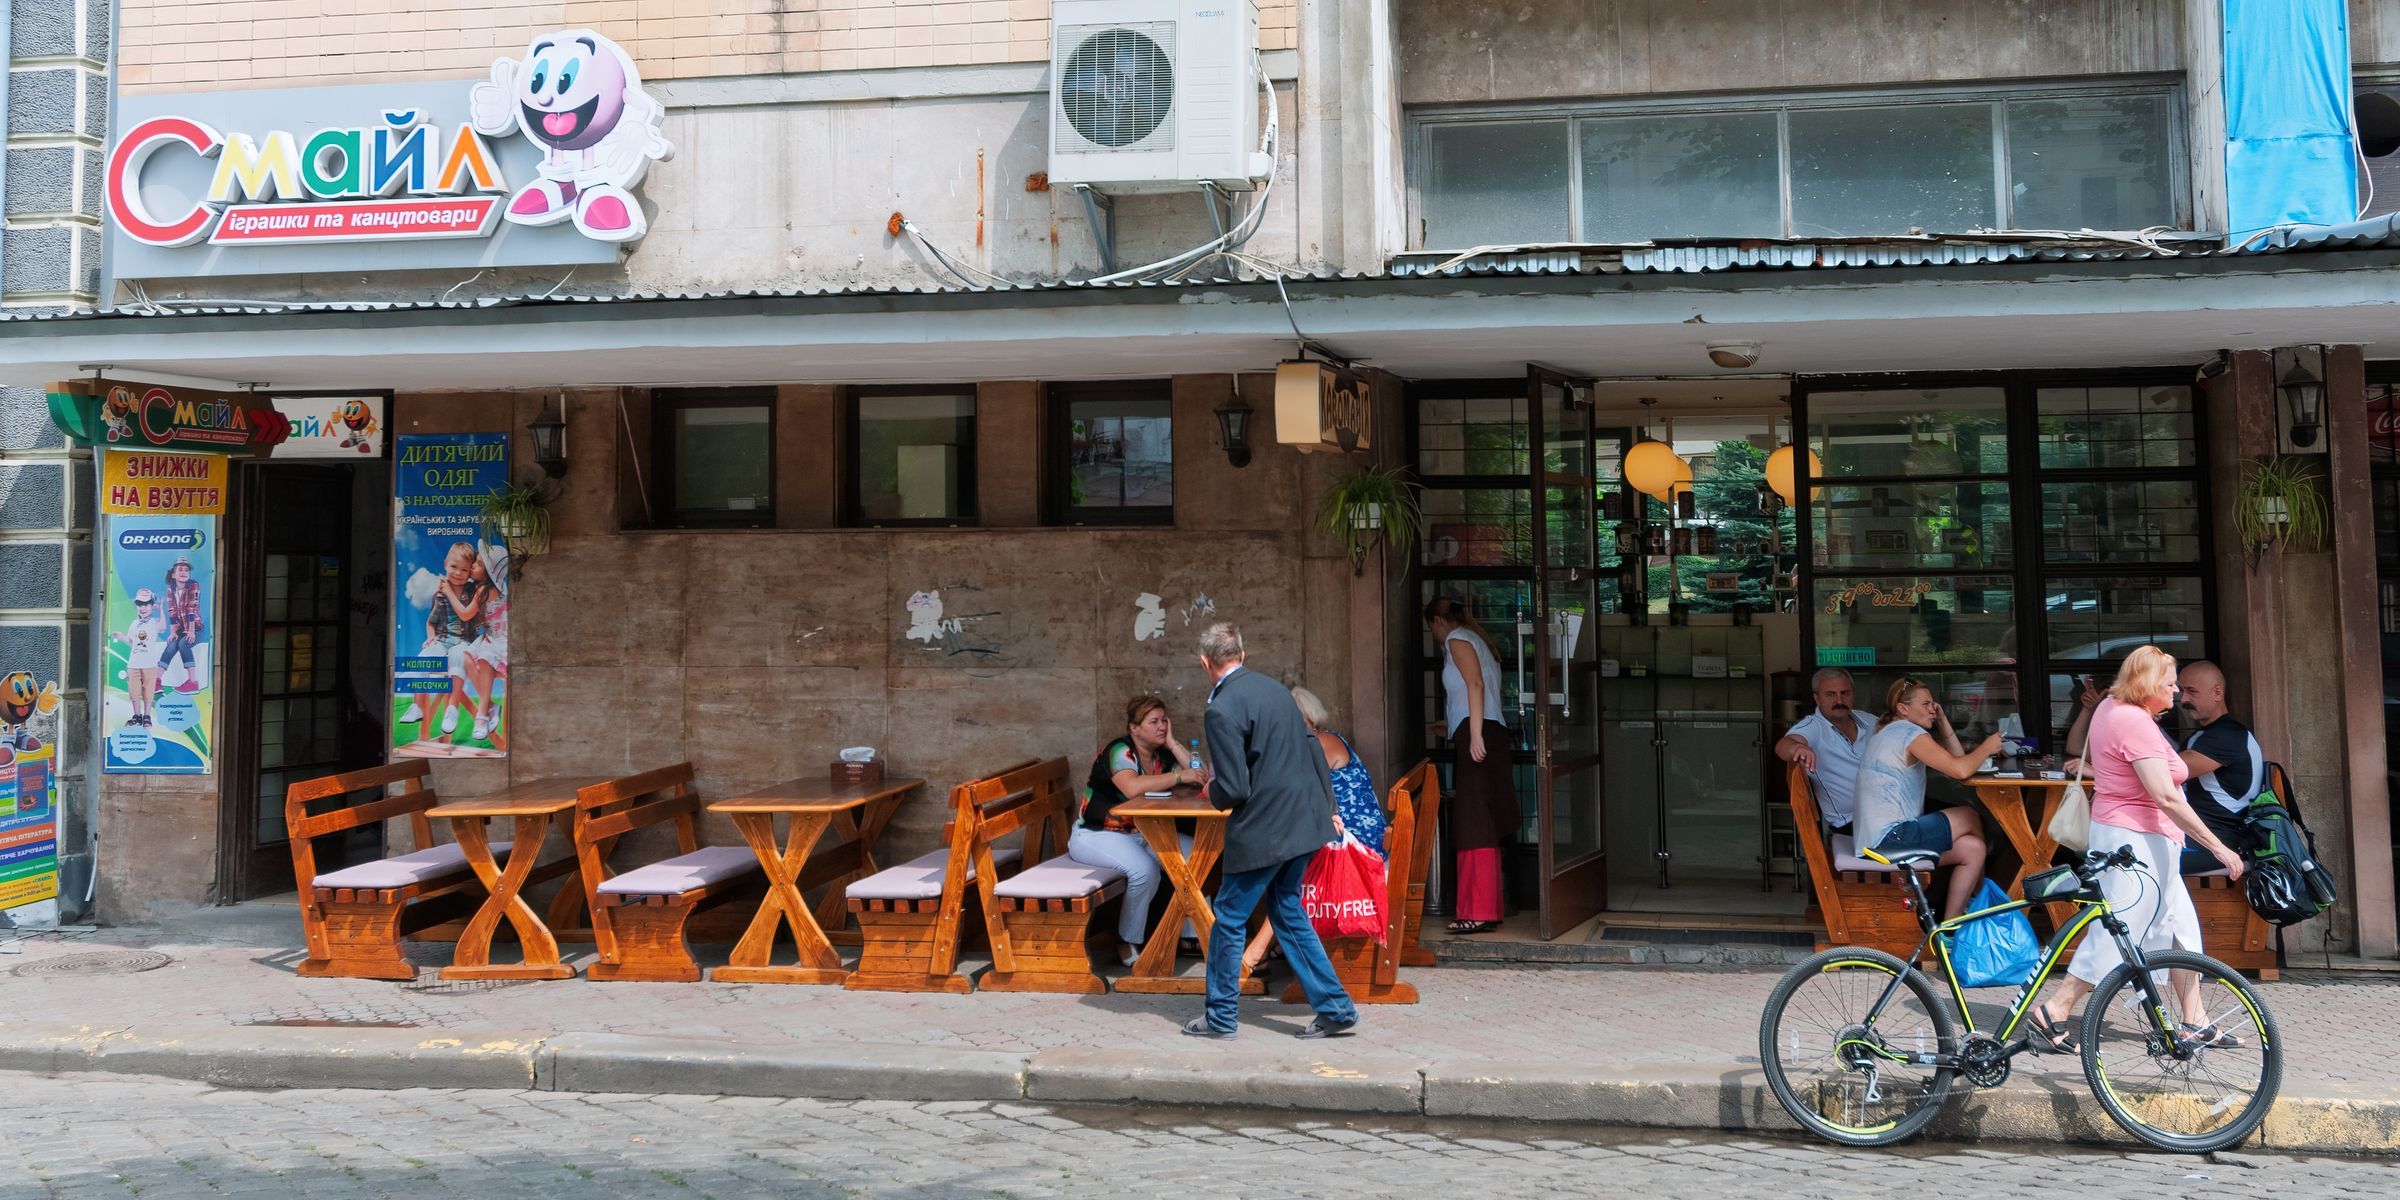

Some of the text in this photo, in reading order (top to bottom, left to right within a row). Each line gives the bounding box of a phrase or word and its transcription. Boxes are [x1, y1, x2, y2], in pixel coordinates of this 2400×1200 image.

[107, 109, 503, 247] Смайл
[229, 208, 478, 235] іграшки та канцтовари
[138, 387, 248, 445] Смайл
[288, 415, 337, 438] айл
[400, 440, 504, 467] ДИТЯЧИЙ
[126, 455, 209, 479] ЗНИЖКИ
[424, 468, 479, 490] ОДЯГ
[111, 485, 219, 509] НА ВЗУТТЯ
[413, 494, 491, 507] НАРОДЖЕНН
[447, 515, 455, 524] ТА
[427, 527, 474, 536] ВИРОБНИКІВ
[406, 660, 442, 669] КОЛГОТИ
[411, 681, 449, 690] НОСОЧКИ
